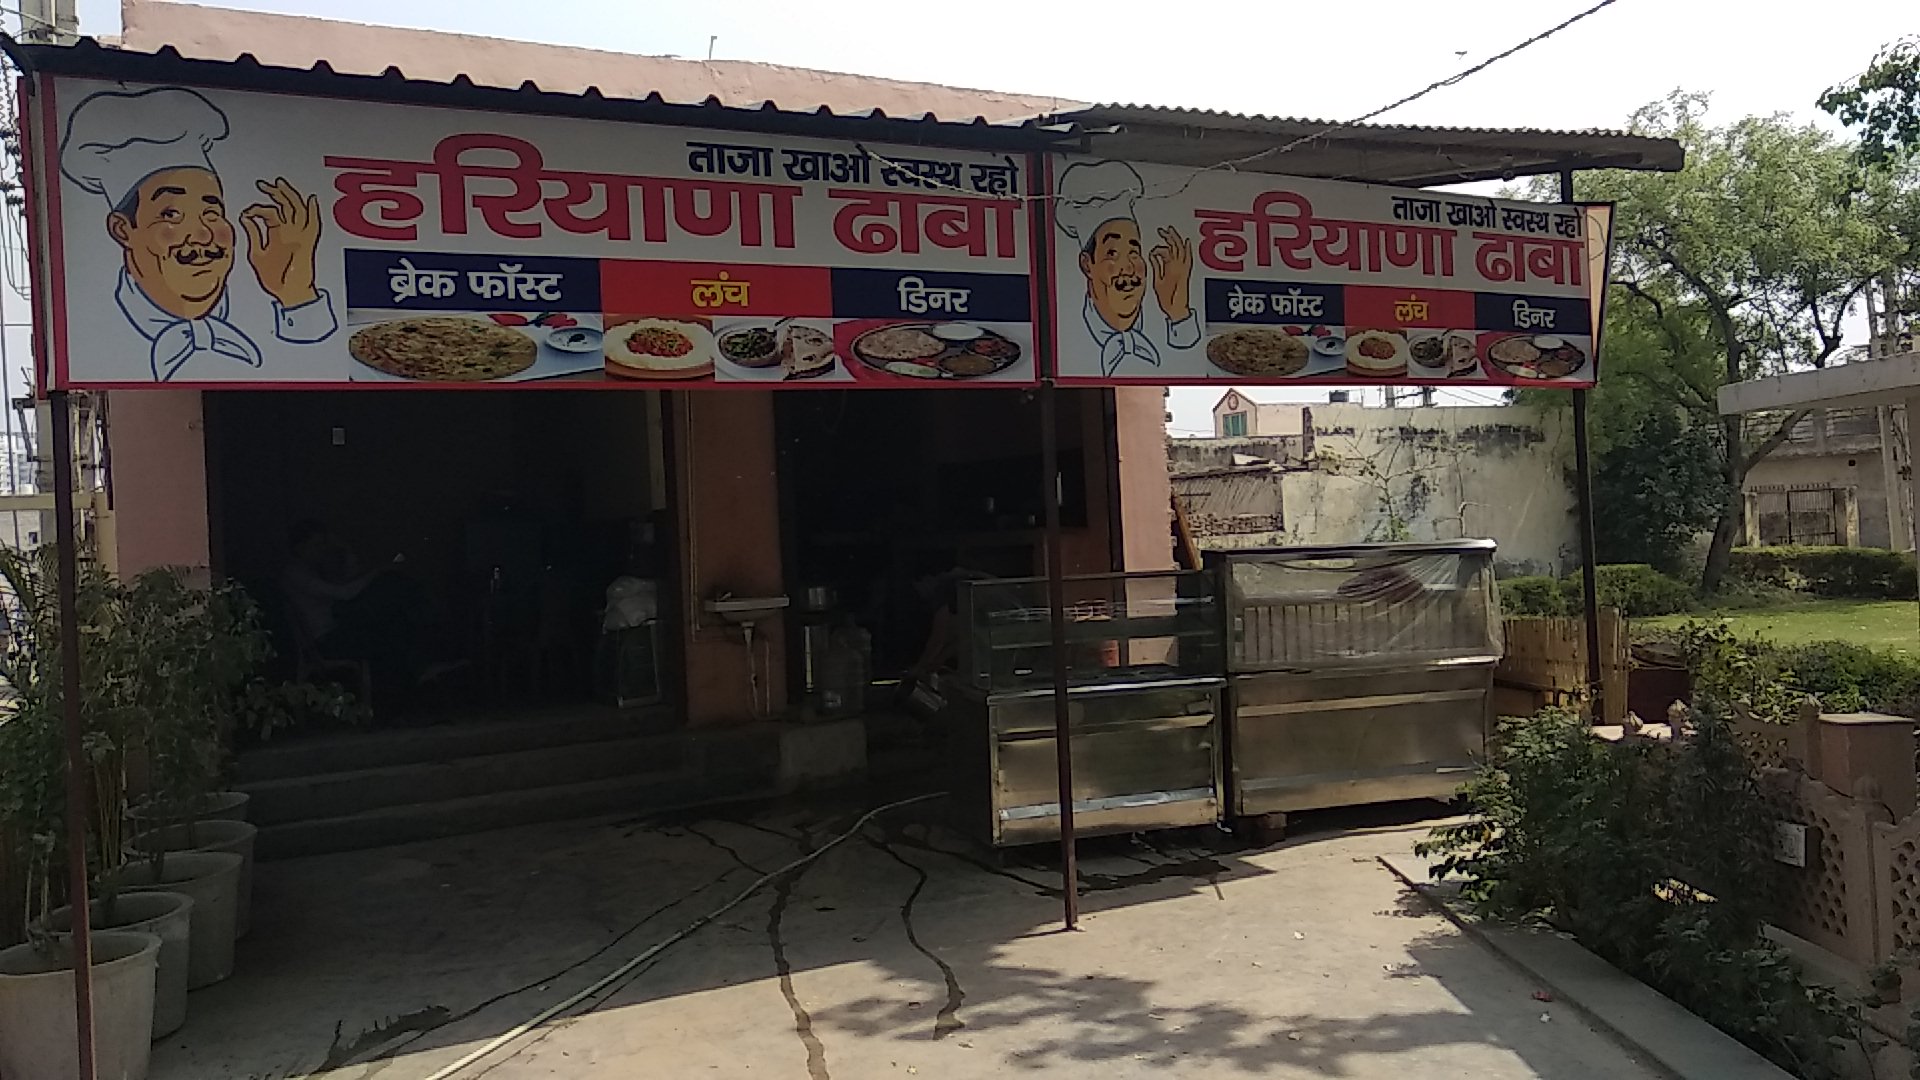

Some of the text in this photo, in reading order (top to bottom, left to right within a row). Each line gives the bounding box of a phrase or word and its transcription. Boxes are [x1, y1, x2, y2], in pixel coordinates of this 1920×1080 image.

[686, 141, 1019, 196] ताजा खाओ स्वस्थ रहो
[323, 133, 1022, 259] हरियाणा ढाबा
[1391, 196, 1582, 238] ताजा खाओ स्वस्थ रहो
[1194, 191, 1584, 286] हरियाणा ढाबा
[388, 258, 563, 302] ब्रेक फॉस्ट
[690, 271, 750, 307] लंच
[897, 276, 971, 313] डिनर
[1227, 283, 1324, 318] ब्रेक फॉस्ट
[1394, 294, 1429, 321] लंच
[1512, 299, 1556, 328] डिनर
